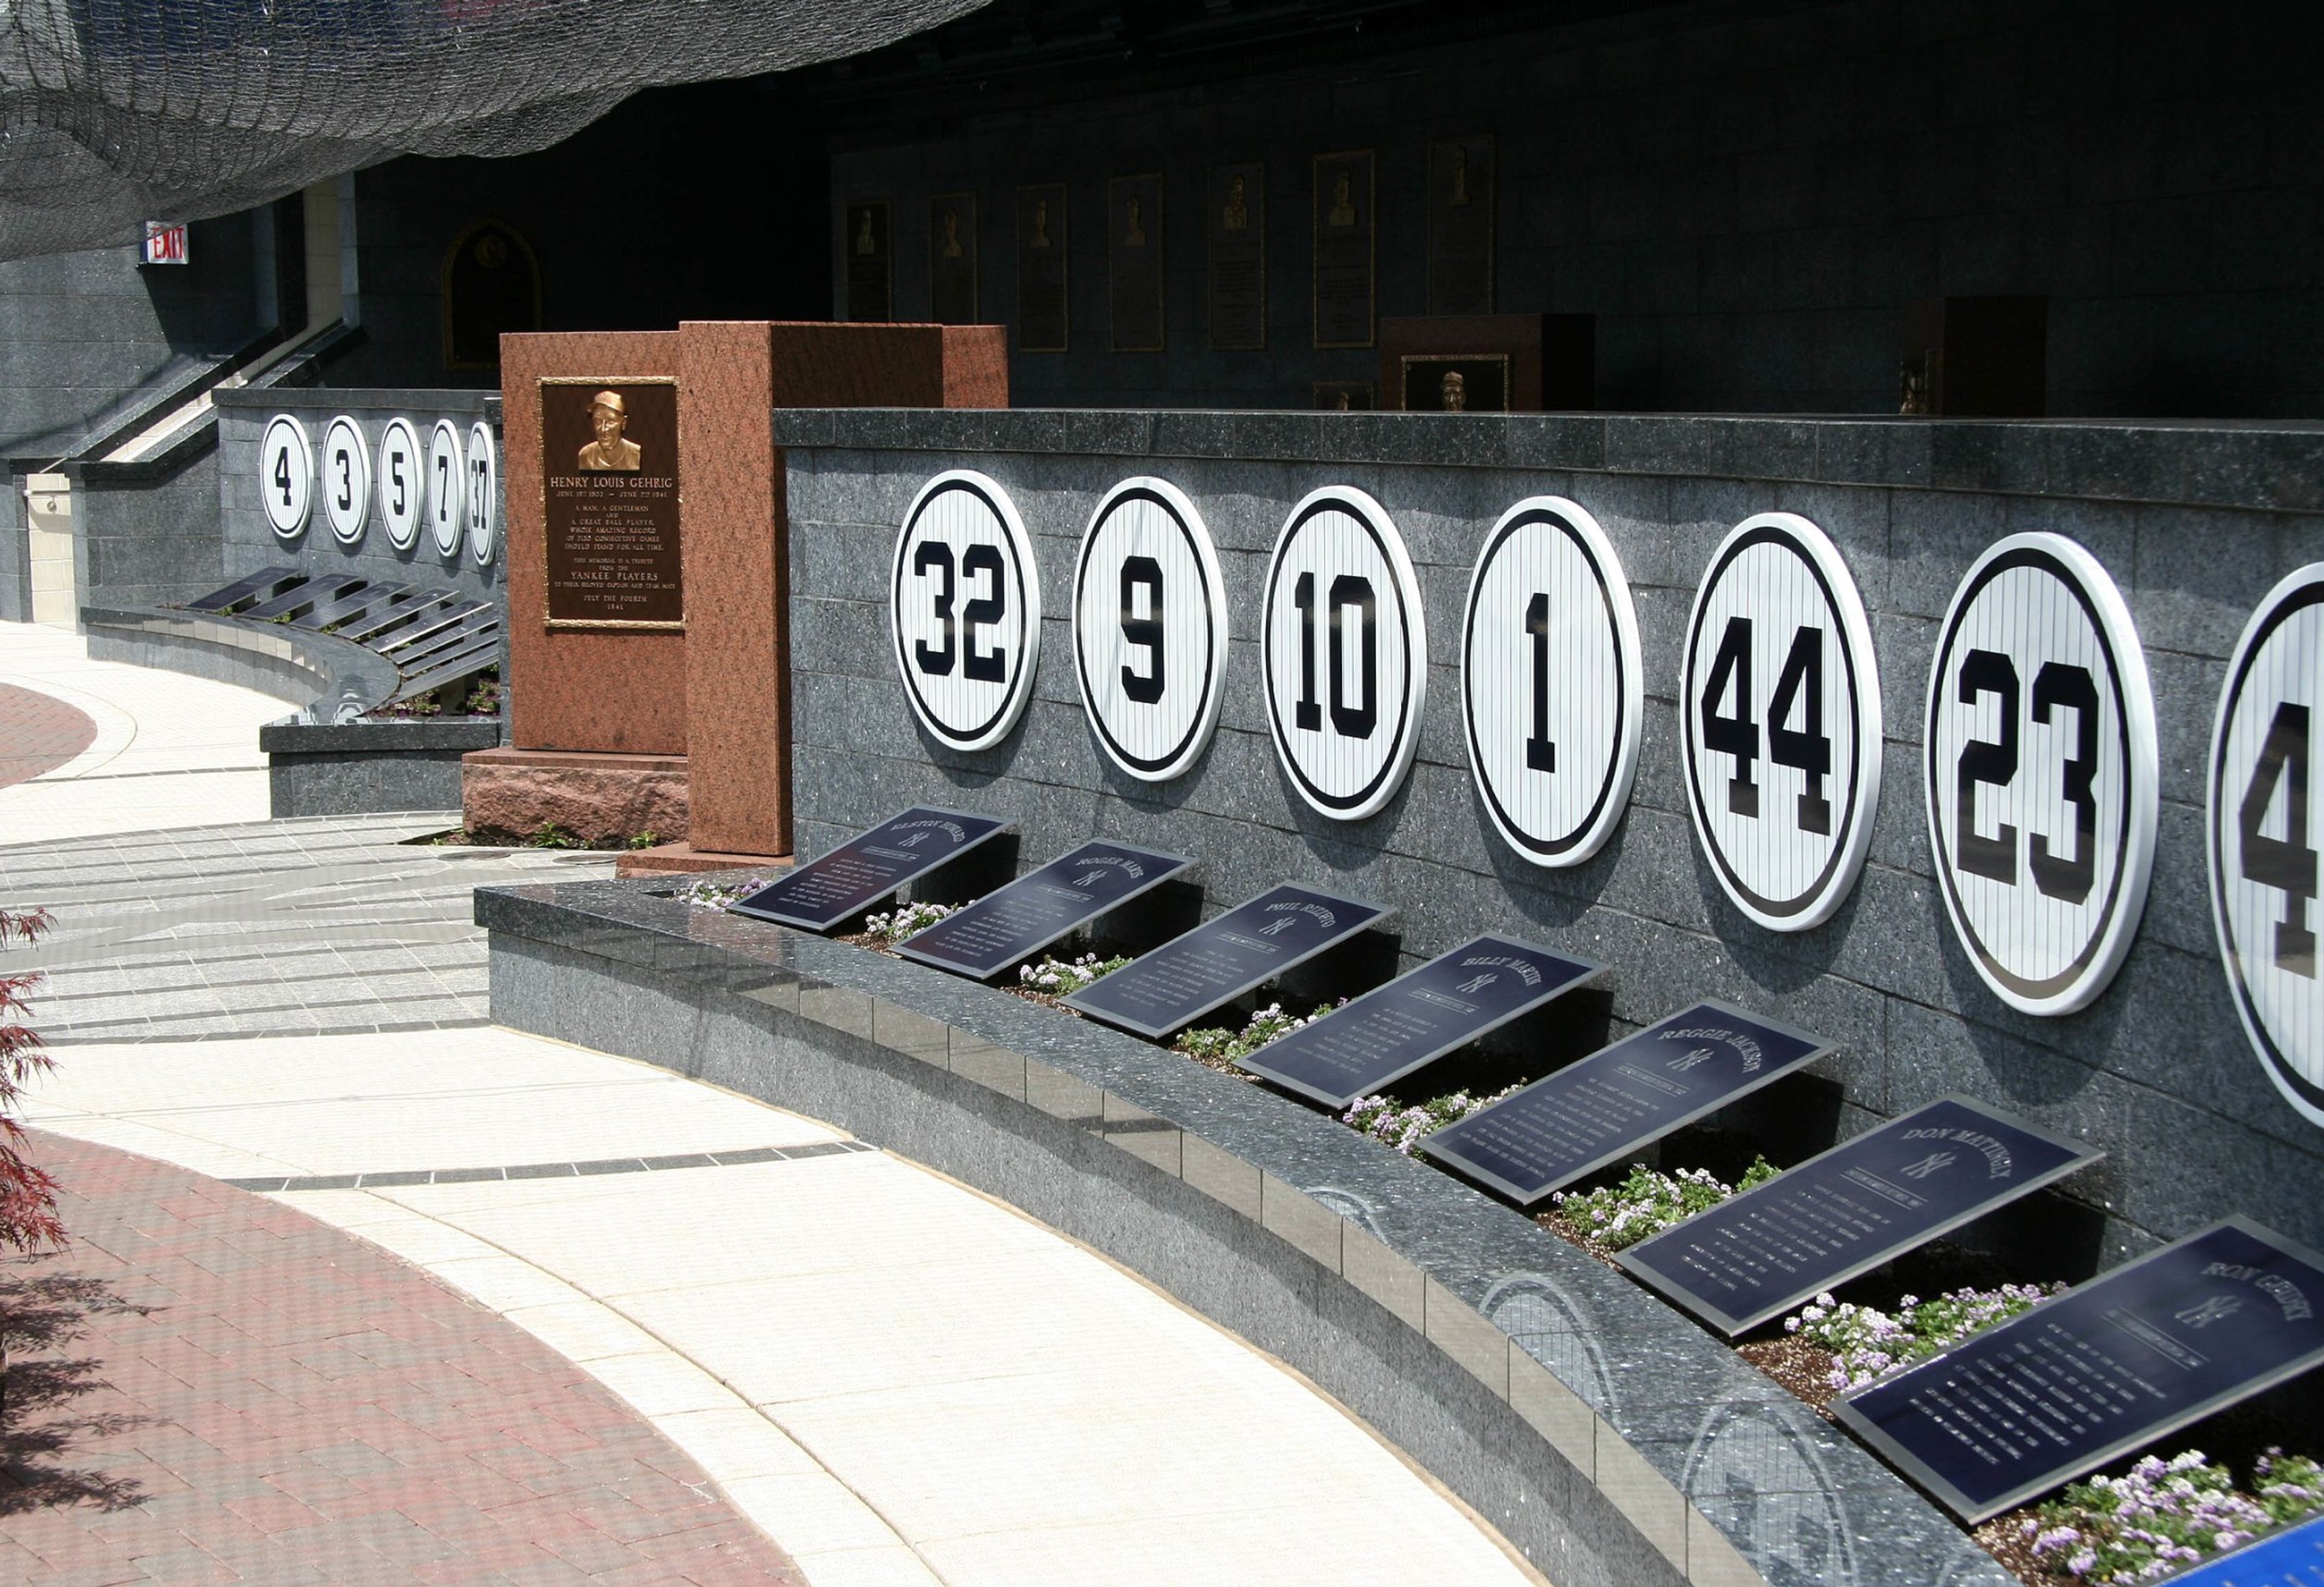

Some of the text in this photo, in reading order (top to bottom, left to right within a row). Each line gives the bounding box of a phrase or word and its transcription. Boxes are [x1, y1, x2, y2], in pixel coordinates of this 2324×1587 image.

[154, 226, 183, 259] EXIT
[275, 447, 291, 506] 4
[336, 449, 351, 511] 3
[392, 452, 405, 516] 5
[438, 455, 448, 522] 7
[470, 459, 487, 530] 37
[551, 477, 672, 488] HENRY LOUIS GEHRIG
[571, 571, 658, 581] YANKEE PLAYERS
[914, 540, 1006, 683] 32
[1120, 555, 1165, 705] 9
[1295, 571, 1377, 740] 10
[1525, 593, 1555, 774] 1
[1701, 616, 1831, 836] 44
[1957, 648, 2099, 905] 23
[890, 820, 942, 831] ELSTON
[1075, 856, 1124, 866] ROGER
[1264, 902, 1302, 912] PHIL
[1460, 956, 1541, 987] BILLY MARTIN
[1656, 1028, 1762, 1074] REGGIE JACKSON
[1900, 1128, 2012, 1180] DON MATTINGLY
[2199, 1261, 2263, 1281] RON
